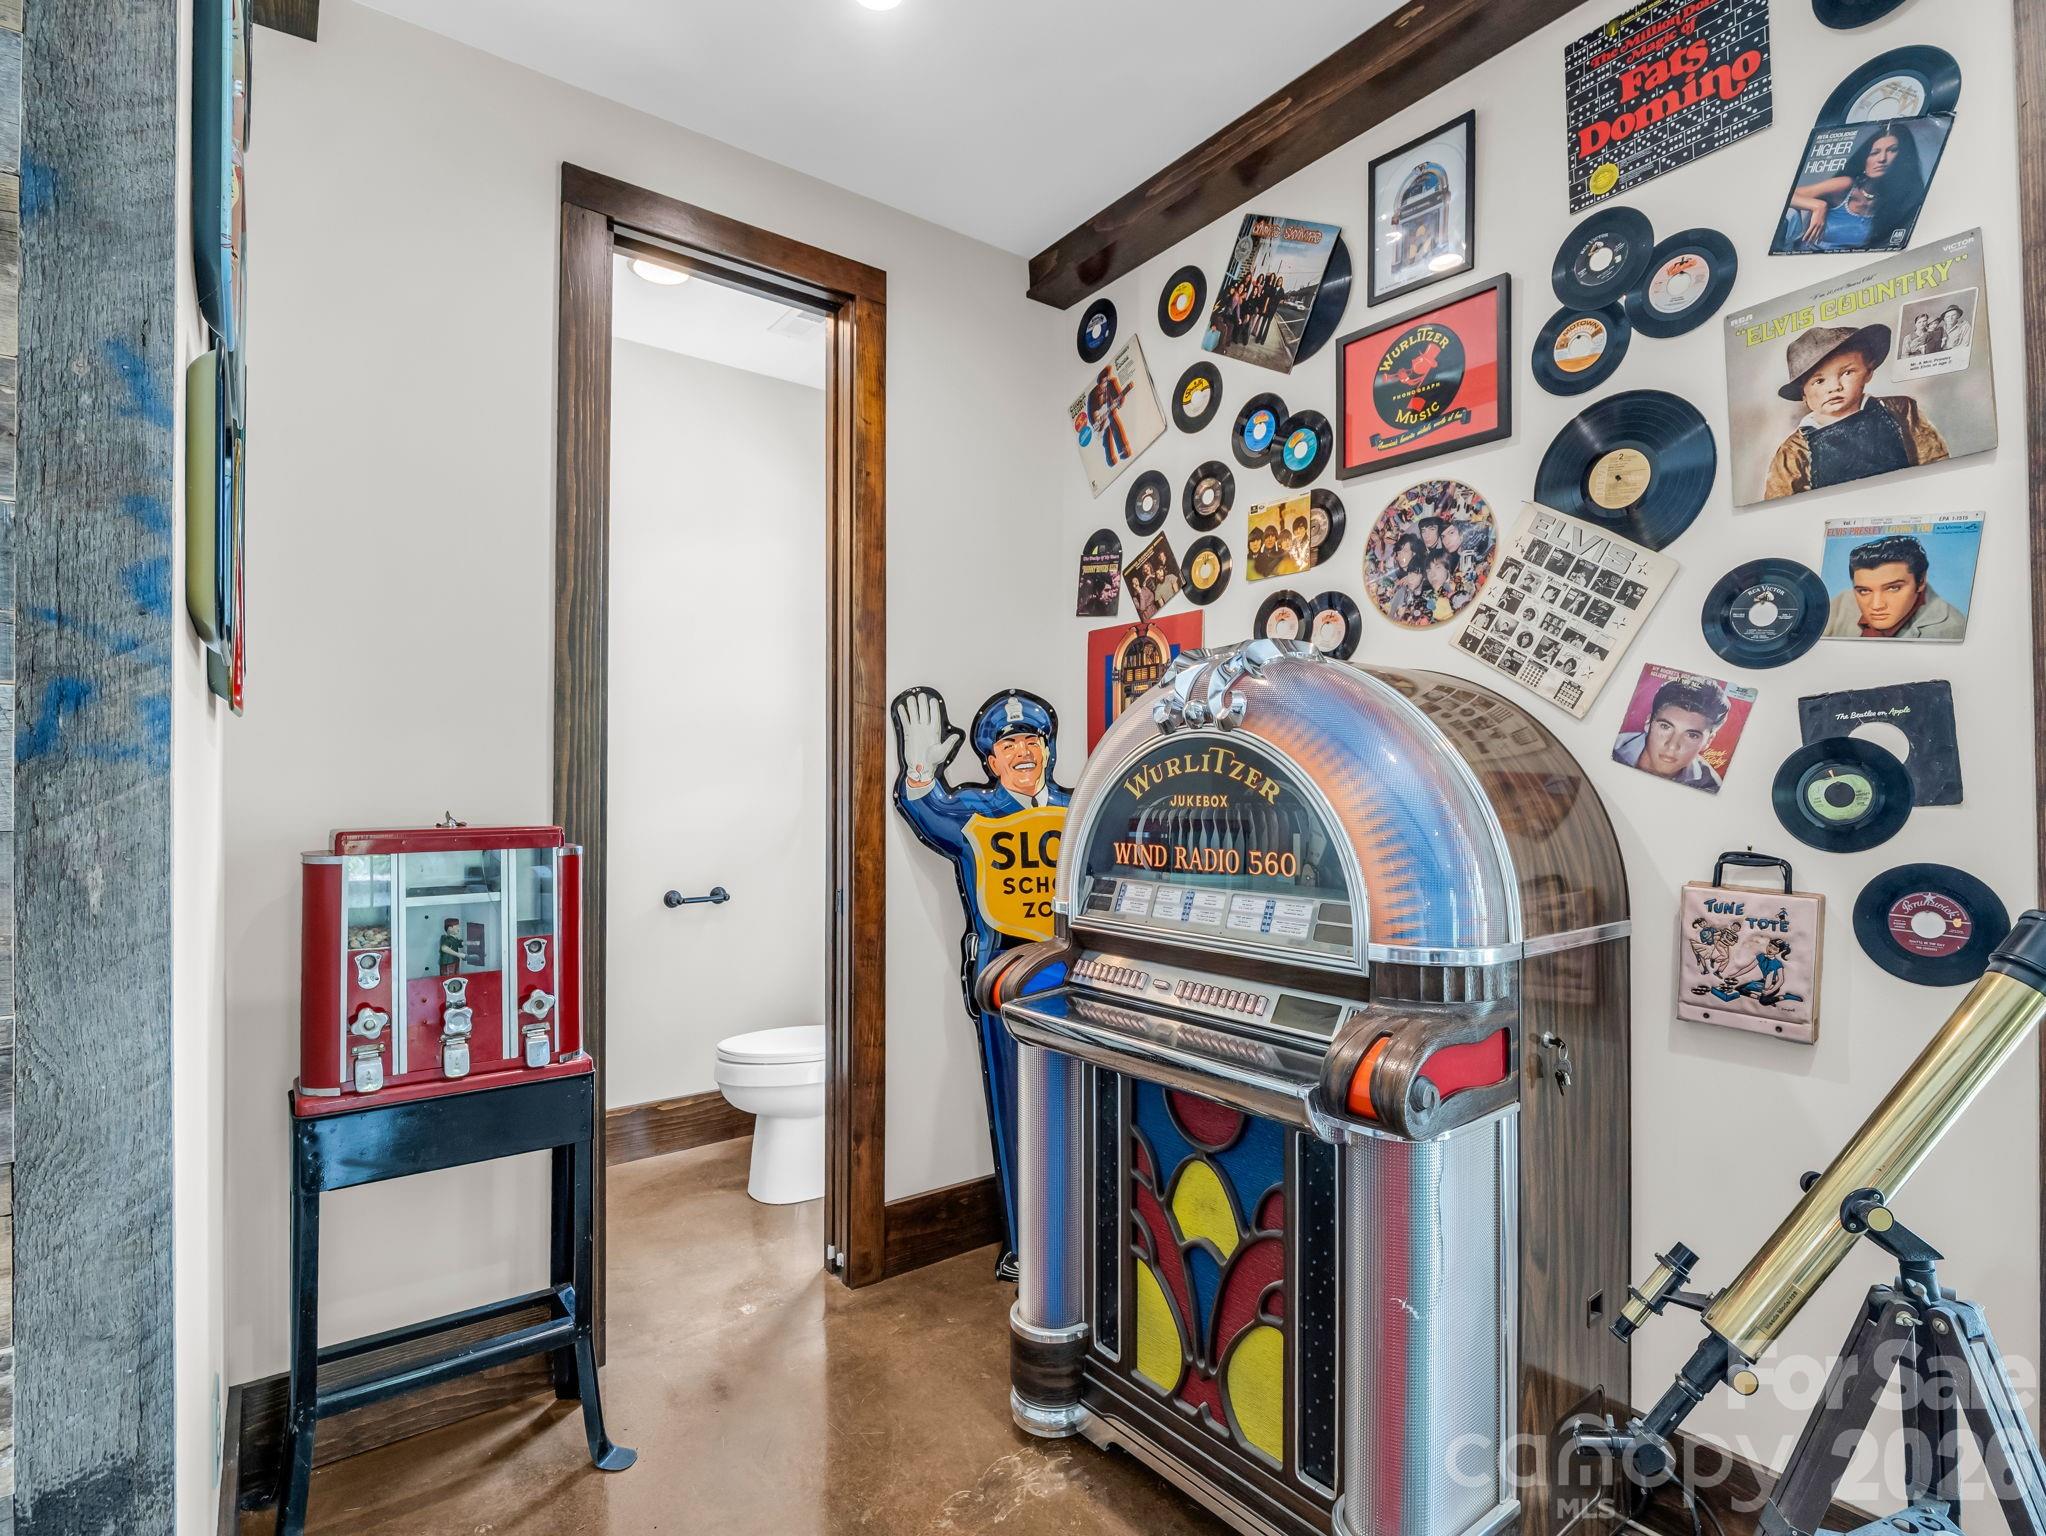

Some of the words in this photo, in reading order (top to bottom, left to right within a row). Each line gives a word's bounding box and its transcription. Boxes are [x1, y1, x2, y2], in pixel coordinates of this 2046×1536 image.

[1591, 50, 1618, 68] The
[1621, 14, 1683, 52] Million
[1626, 30, 1677, 63] Magic
[1680, 16, 1697, 35] of
[1618, 38, 1710, 104] Fats
[1577, 50, 1762, 160] Domino
[1810, 141, 1854, 157] HIGHER
[1804, 158, 1847, 174] HIGHER
[1730, 314, 1753, 327] RCA
[1942, 237, 1975, 252] VICTOR
[1562, 320, 1600, 337] MOTOWN
[1379, 327, 1450, 372] WURLITZER
[1392, 382, 1441, 401] PHONOGRAPH
[1395, 401, 1440, 424] MUSIC
[1617, 453, 1624, 461] 2
[1827, 527, 1848, 537] ELVIS
[1850, 525, 1883, 536] PRESLEY
[1528, 511, 1637, 574] ELVIS
[1747, 587, 1761, 596] RCA
[1761, 585, 1785, 596] VICTOR
[1850, 710, 1876, 719] Beatles
[1888, 706, 1911, 716] Apple
[1124, 747, 1280, 804] WURLITZER
[1170, 795, 1229, 808] JUKEBOX
[990, 829, 1062, 871] SLO
[1113, 841, 1168, 869] WIND
[1174, 846, 1240, 875] RADIO
[1248, 851, 1297, 878] 560
[1003, 876, 1055, 895] SCH
[1023, 901, 1054, 918] ZO
[1704, 899, 1745, 915] TUNE
[1902, 900, 1958, 919] Brunswick
[1745, 917, 1790, 932] TOTE
